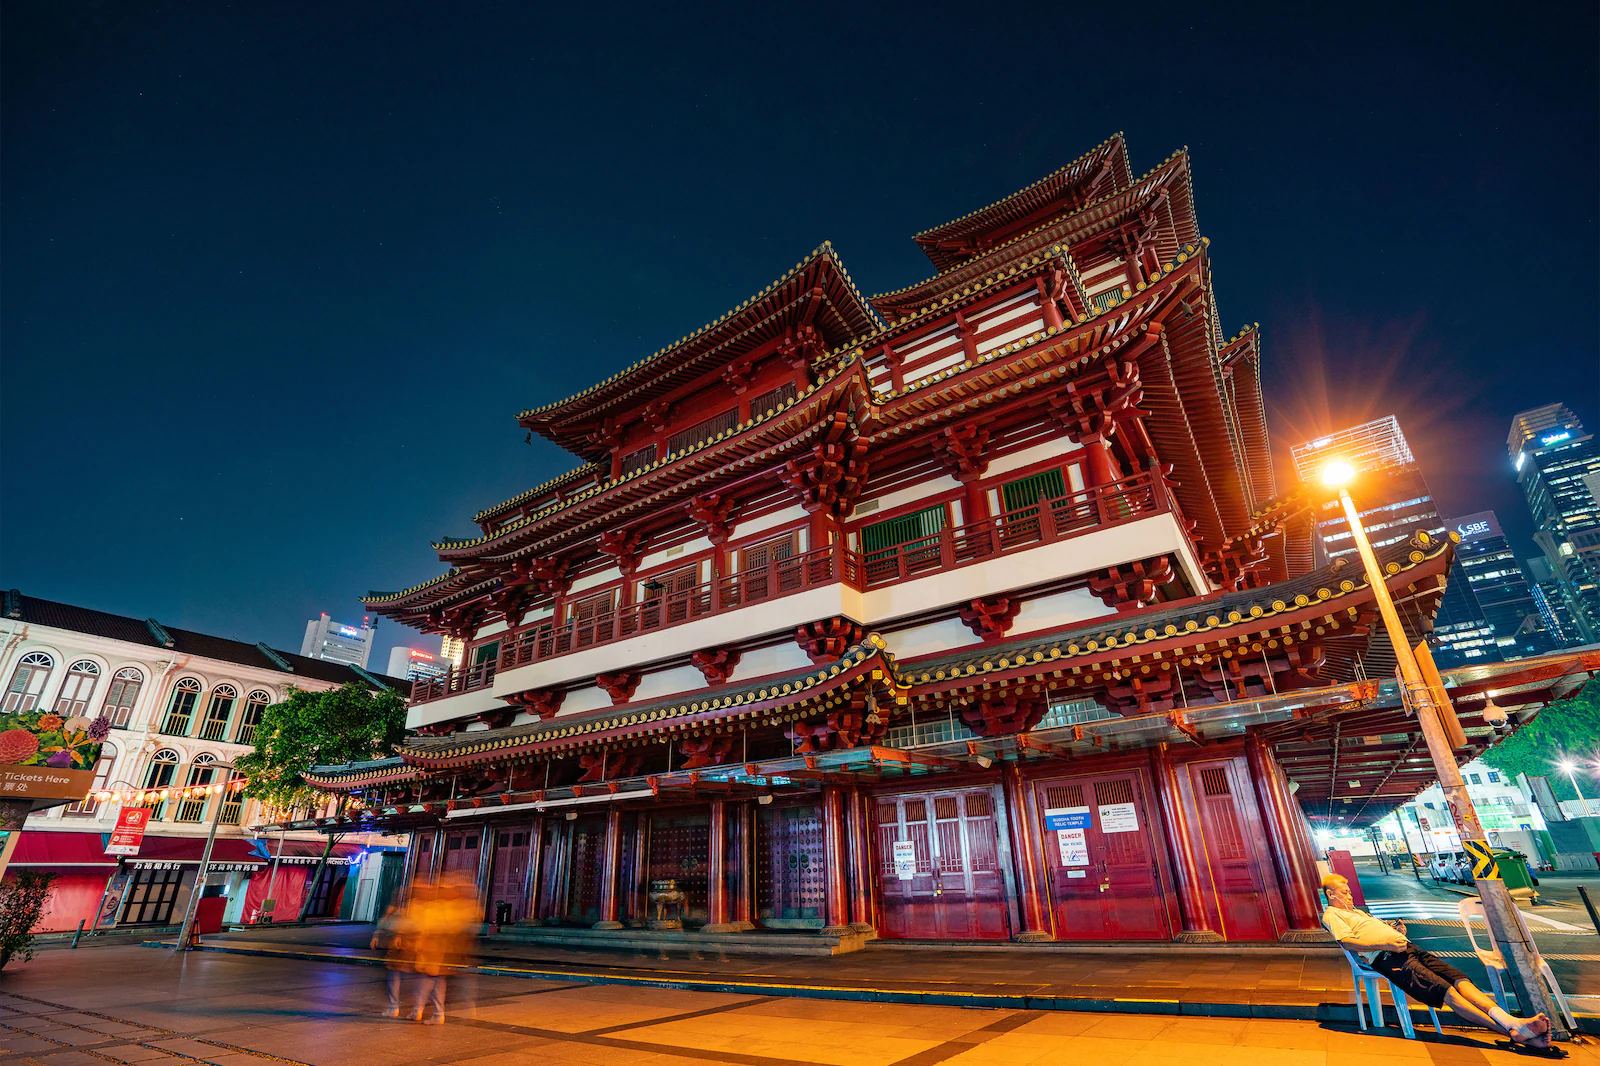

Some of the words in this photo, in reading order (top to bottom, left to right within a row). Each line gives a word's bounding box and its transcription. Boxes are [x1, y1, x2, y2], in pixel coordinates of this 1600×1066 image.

[1466, 521, 1488, 532] SBF
[5, 772, 43, 782] Tickets
[45, 775, 70, 784] Here
[0, 782, 28, 792] 票处
